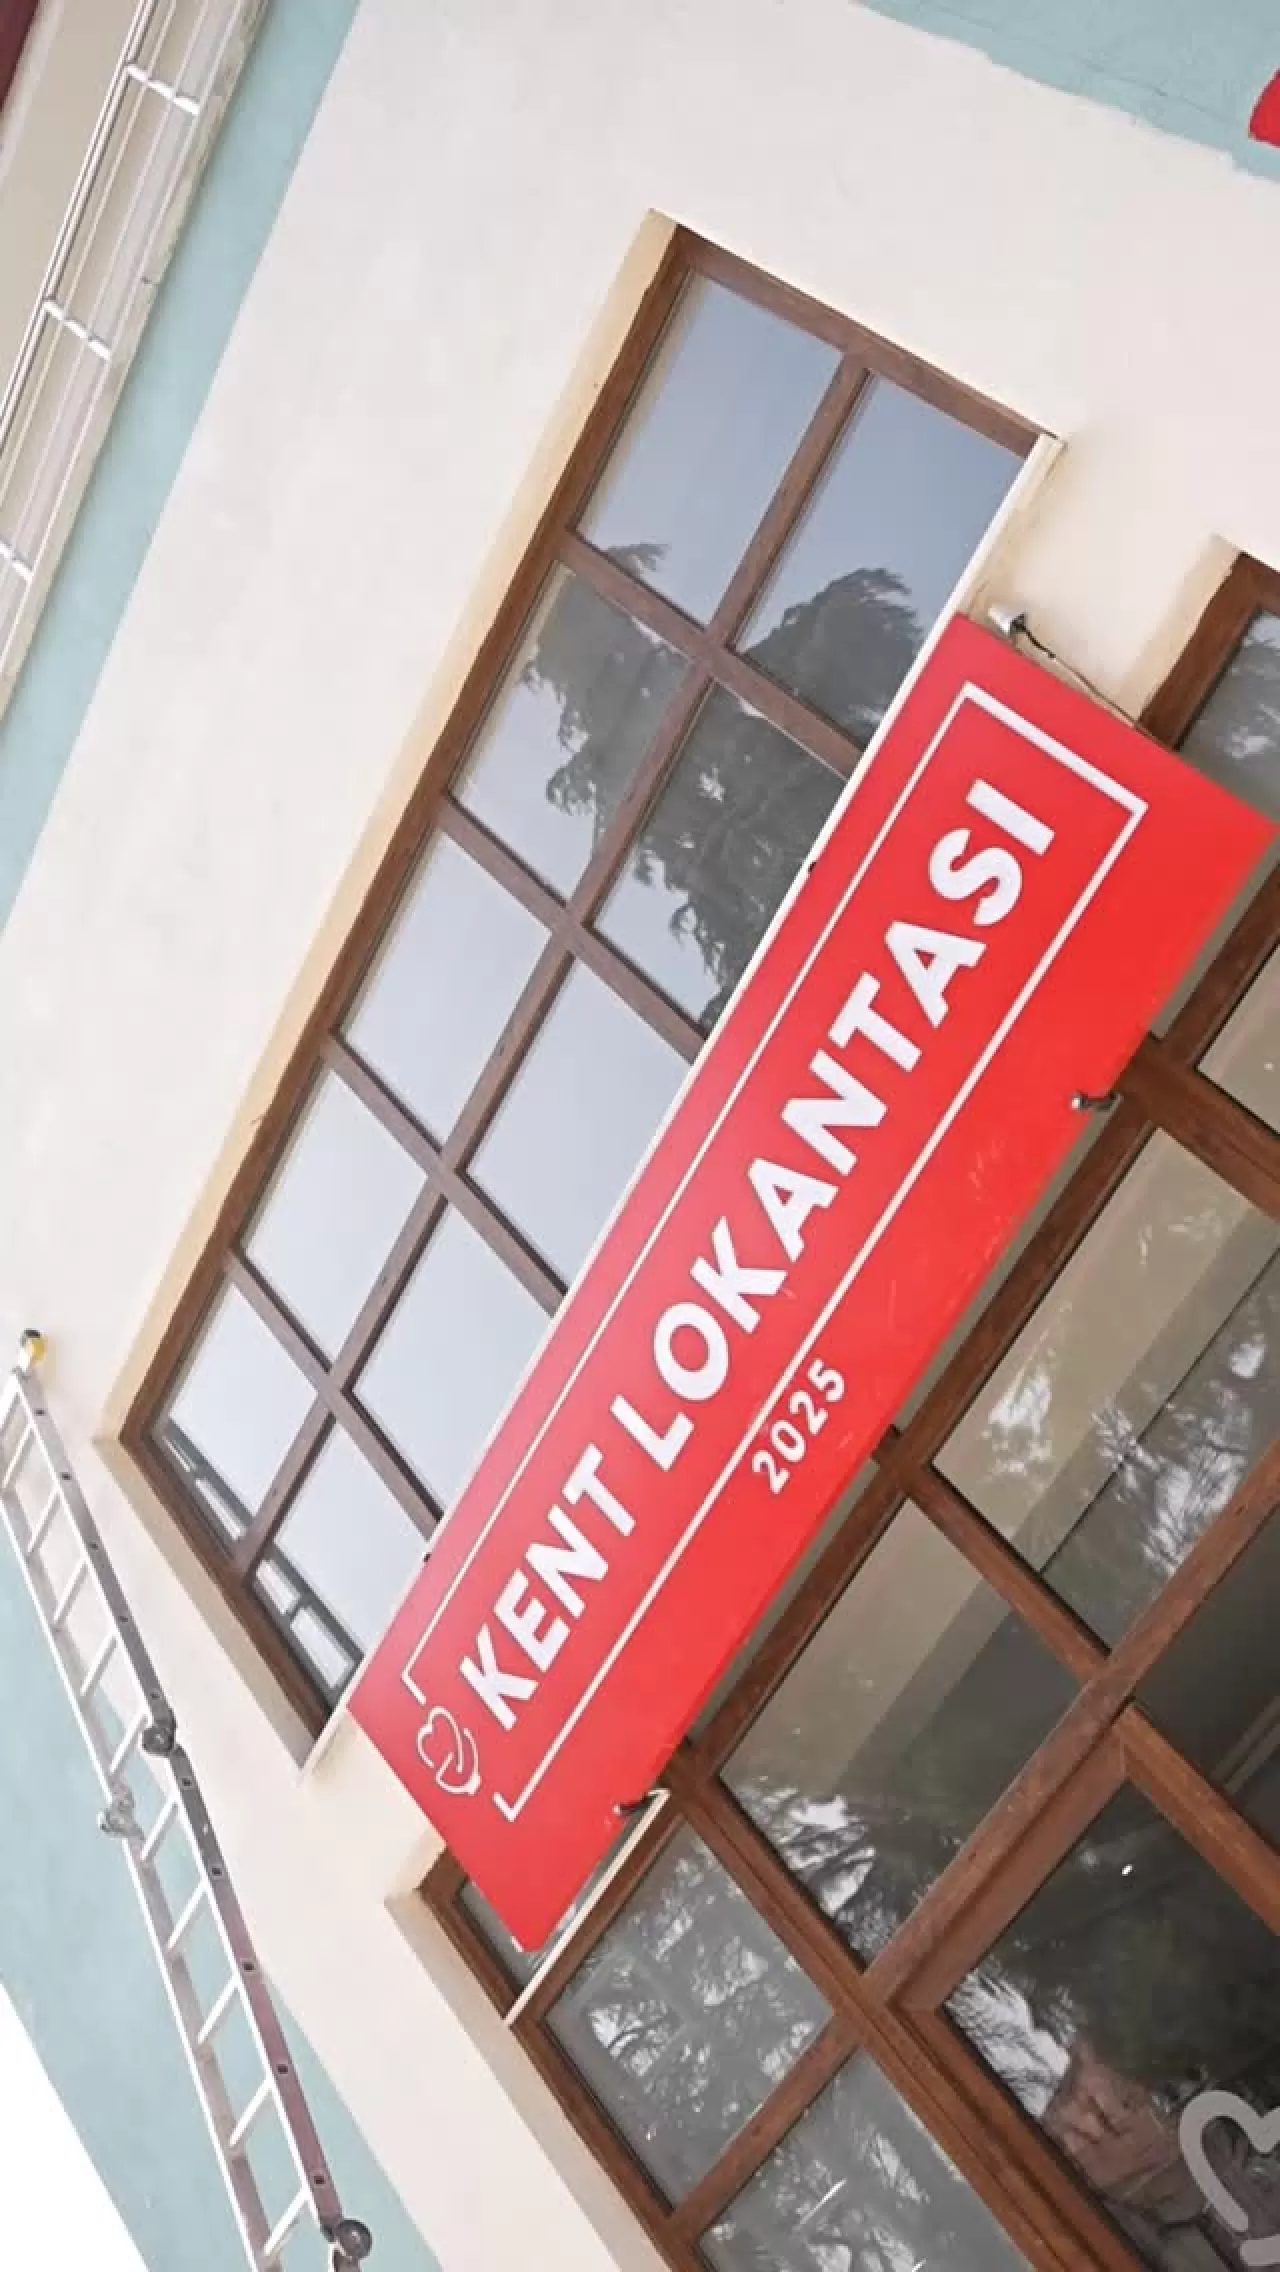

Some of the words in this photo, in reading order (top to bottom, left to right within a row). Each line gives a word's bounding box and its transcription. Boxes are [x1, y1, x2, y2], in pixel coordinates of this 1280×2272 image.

[458, 1442, 636, 1731] KENT
[609, 778, 1056, 1472] LOKANTASI
[750, 1358, 845, 1495] 2025
